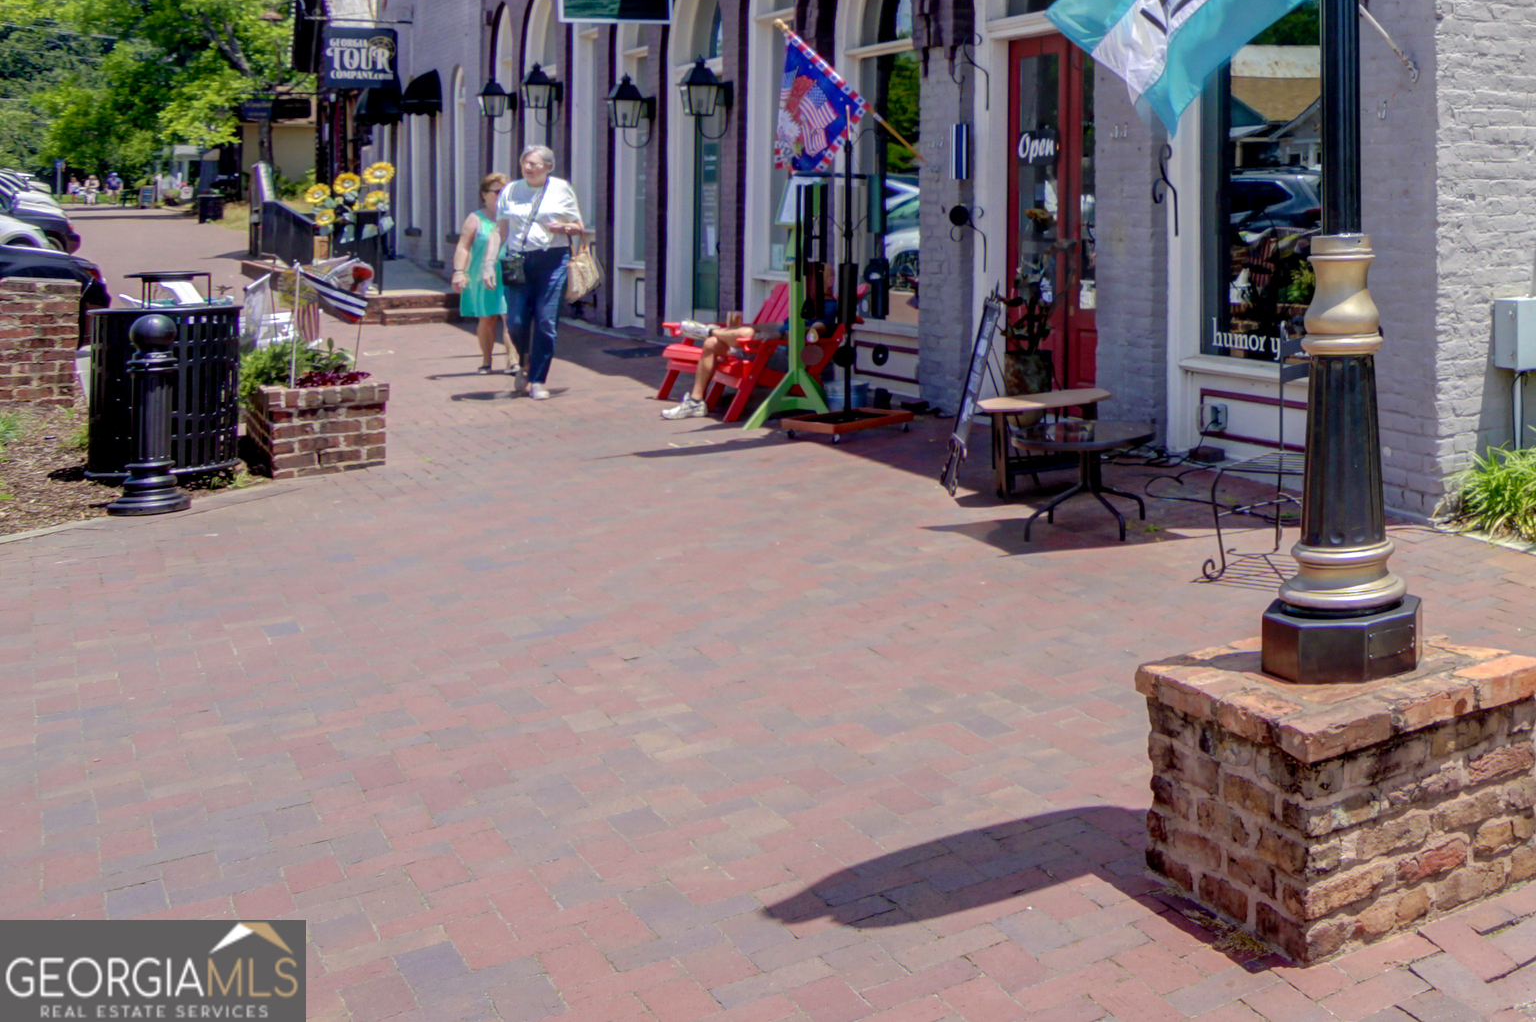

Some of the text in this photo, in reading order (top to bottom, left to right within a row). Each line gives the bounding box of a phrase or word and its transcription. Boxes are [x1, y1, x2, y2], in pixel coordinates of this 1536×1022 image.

[326, 46, 394, 74] TOUR
[1018, 132, 1055, 164] Open
[1212, 317, 1266, 352] humor
